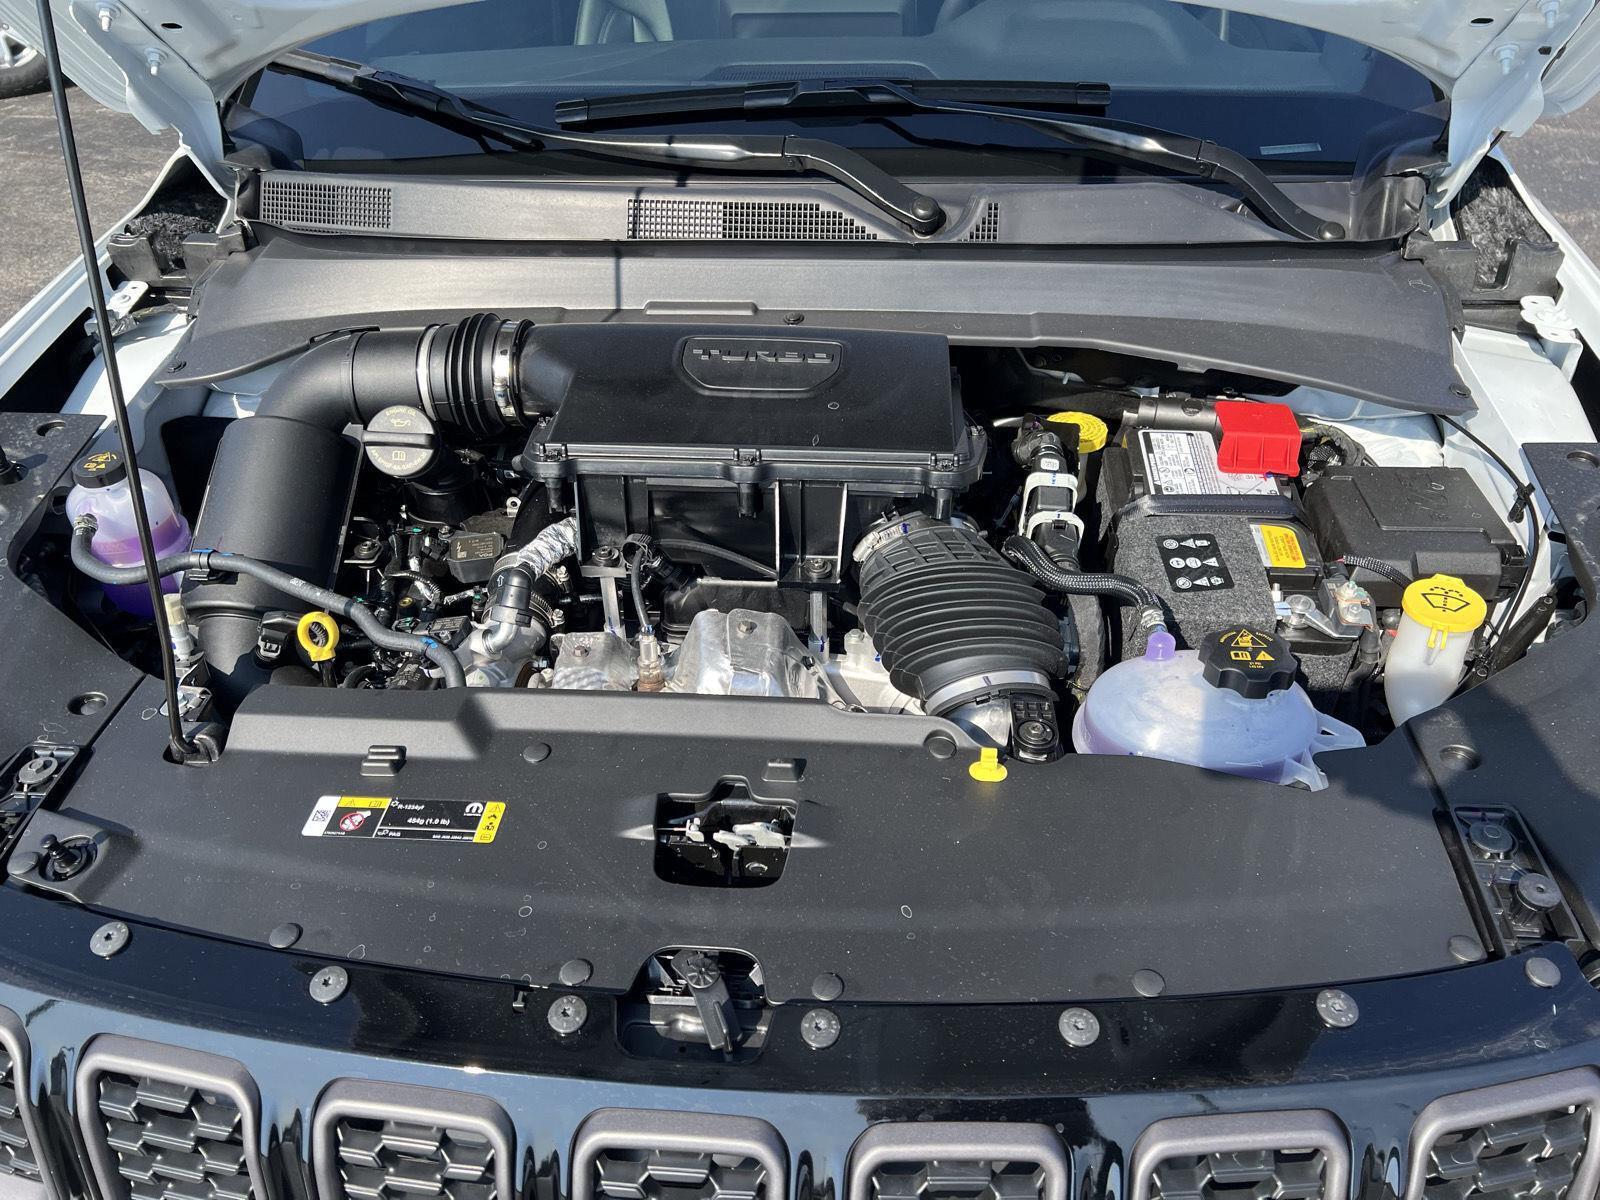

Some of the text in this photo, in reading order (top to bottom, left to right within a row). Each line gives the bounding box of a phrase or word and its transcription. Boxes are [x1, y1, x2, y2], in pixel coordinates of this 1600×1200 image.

[692, 347, 835, 363] TURBO
[397, 803, 425, 811] R-1234yf
[407, 817, 450, 826] 454g (1.0 lb)
